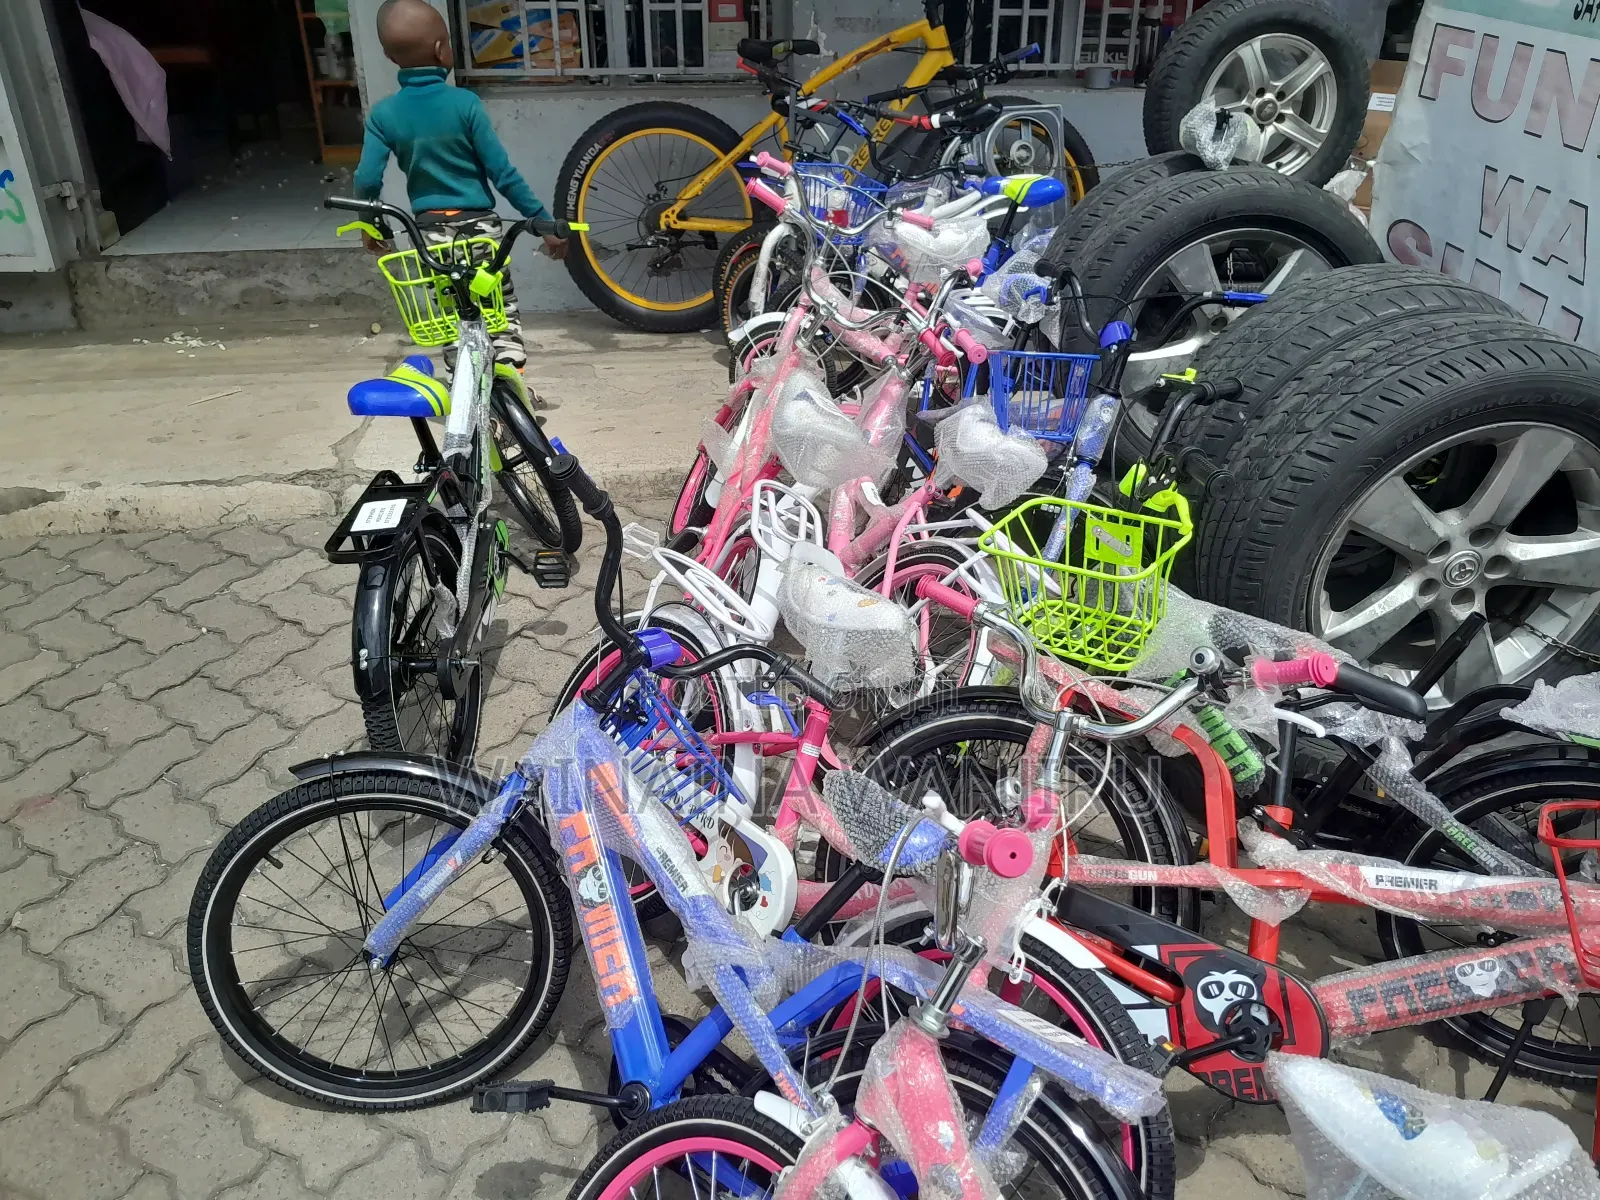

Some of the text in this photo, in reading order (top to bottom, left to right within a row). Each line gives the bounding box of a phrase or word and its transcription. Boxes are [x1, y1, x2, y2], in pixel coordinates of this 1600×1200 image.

[1418, 22, 1600, 159] FUN
[1478, 164, 1588, 287] WA
[1375, 873, 1438, 891] PREMIER
